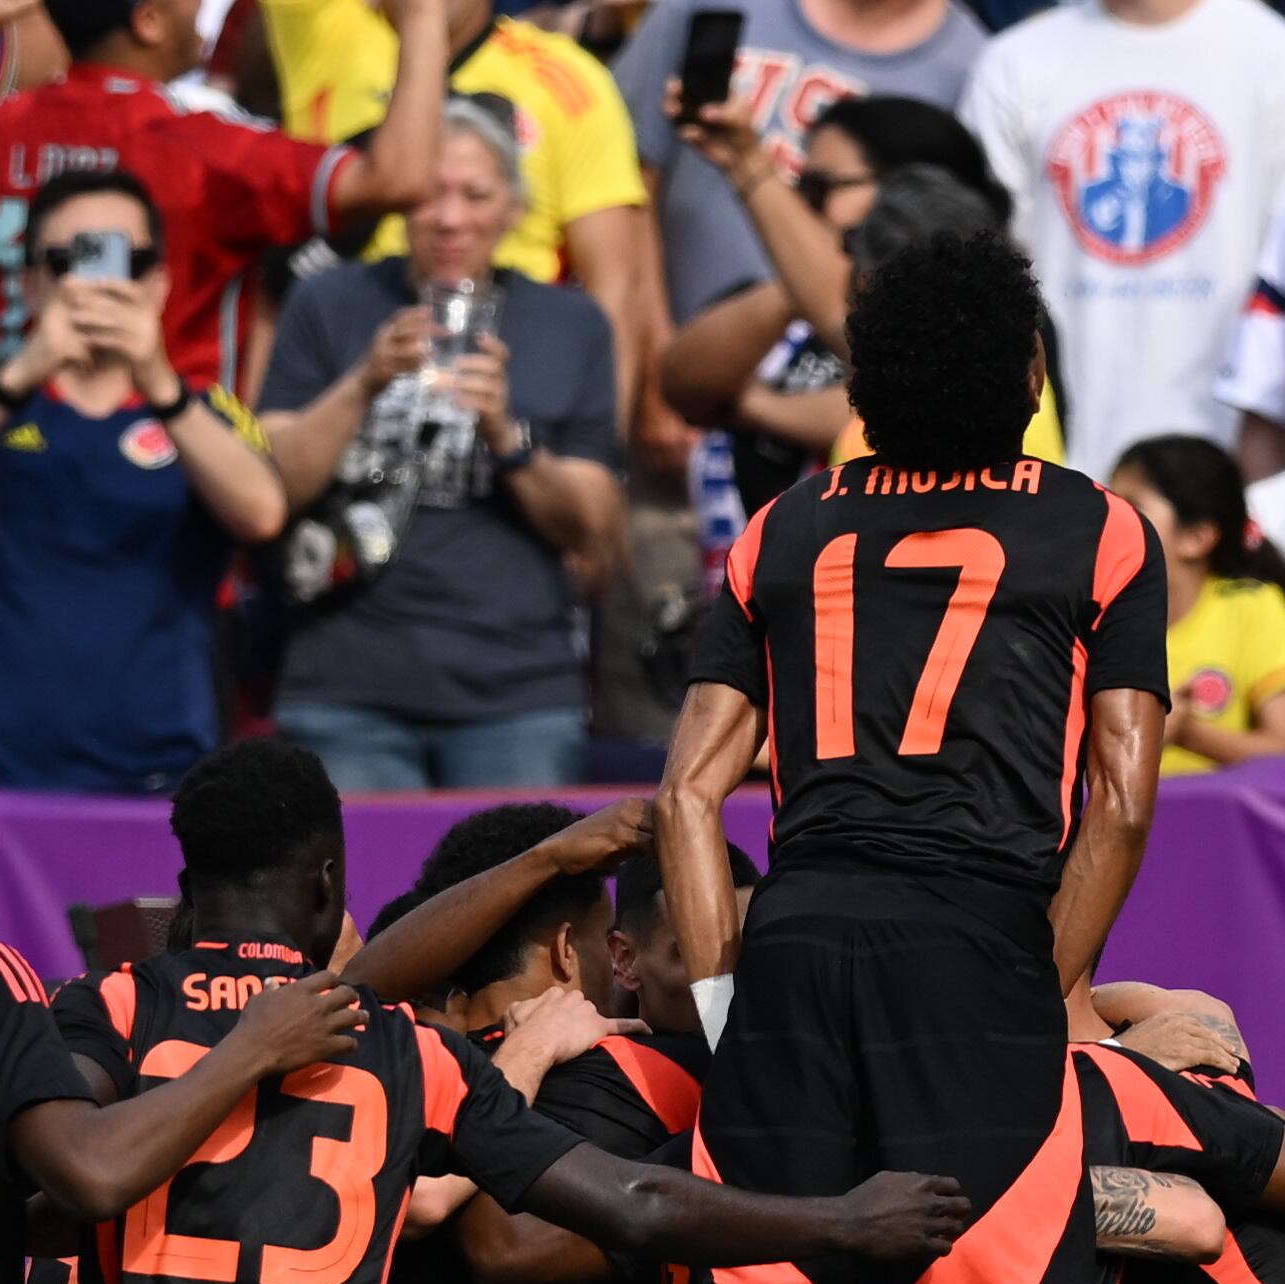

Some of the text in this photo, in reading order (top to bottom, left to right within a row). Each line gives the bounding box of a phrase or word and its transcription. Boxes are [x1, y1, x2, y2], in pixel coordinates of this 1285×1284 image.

[821, 460, 1043, 500] J. MOJICA
[813, 527, 1006, 760] 17
